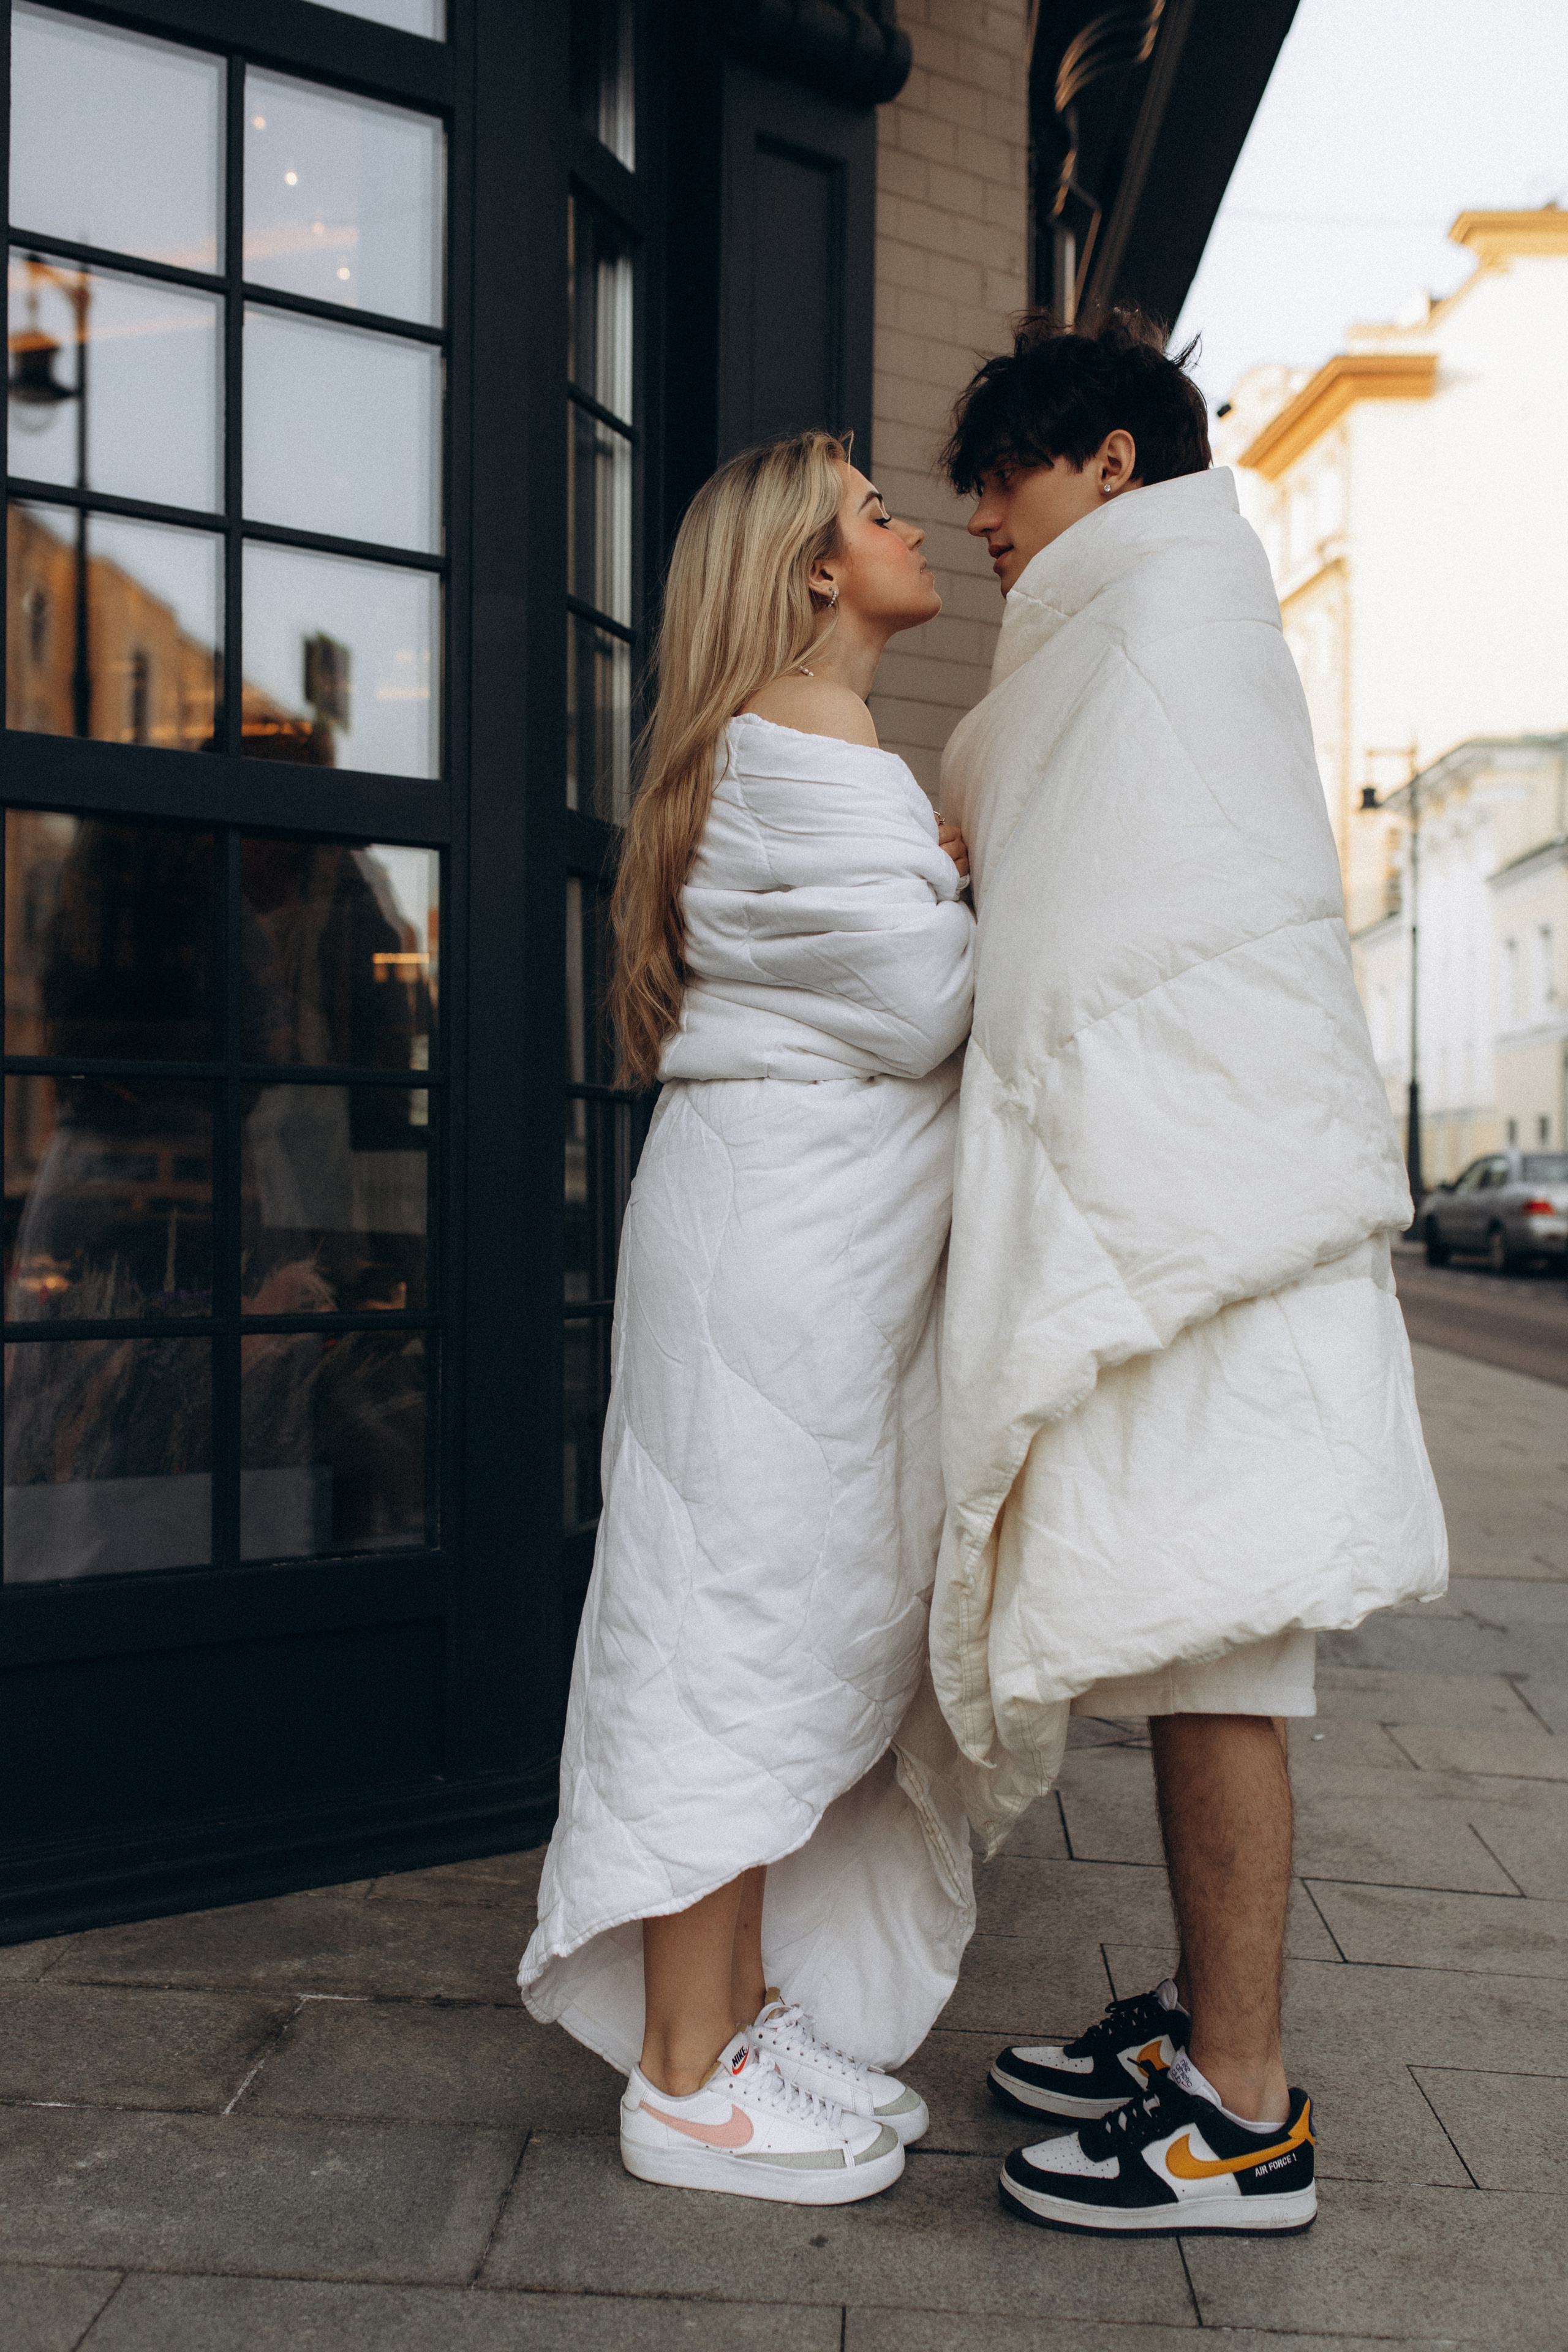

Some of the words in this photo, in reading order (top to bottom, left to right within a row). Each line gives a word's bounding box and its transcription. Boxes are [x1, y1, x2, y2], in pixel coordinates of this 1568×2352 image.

[732, 2045, 747, 2067] NIKE
[1180, 2059, 1191, 2073] nike
[1171, 2069, 1182, 2084] club
[1175, 2064, 1193, 2088] athletic
[1255, 2165, 1268, 2177] AIR
[1268, 2155, 1292, 2171] FORCE
[1292, 2152, 1297, 2162] 1
